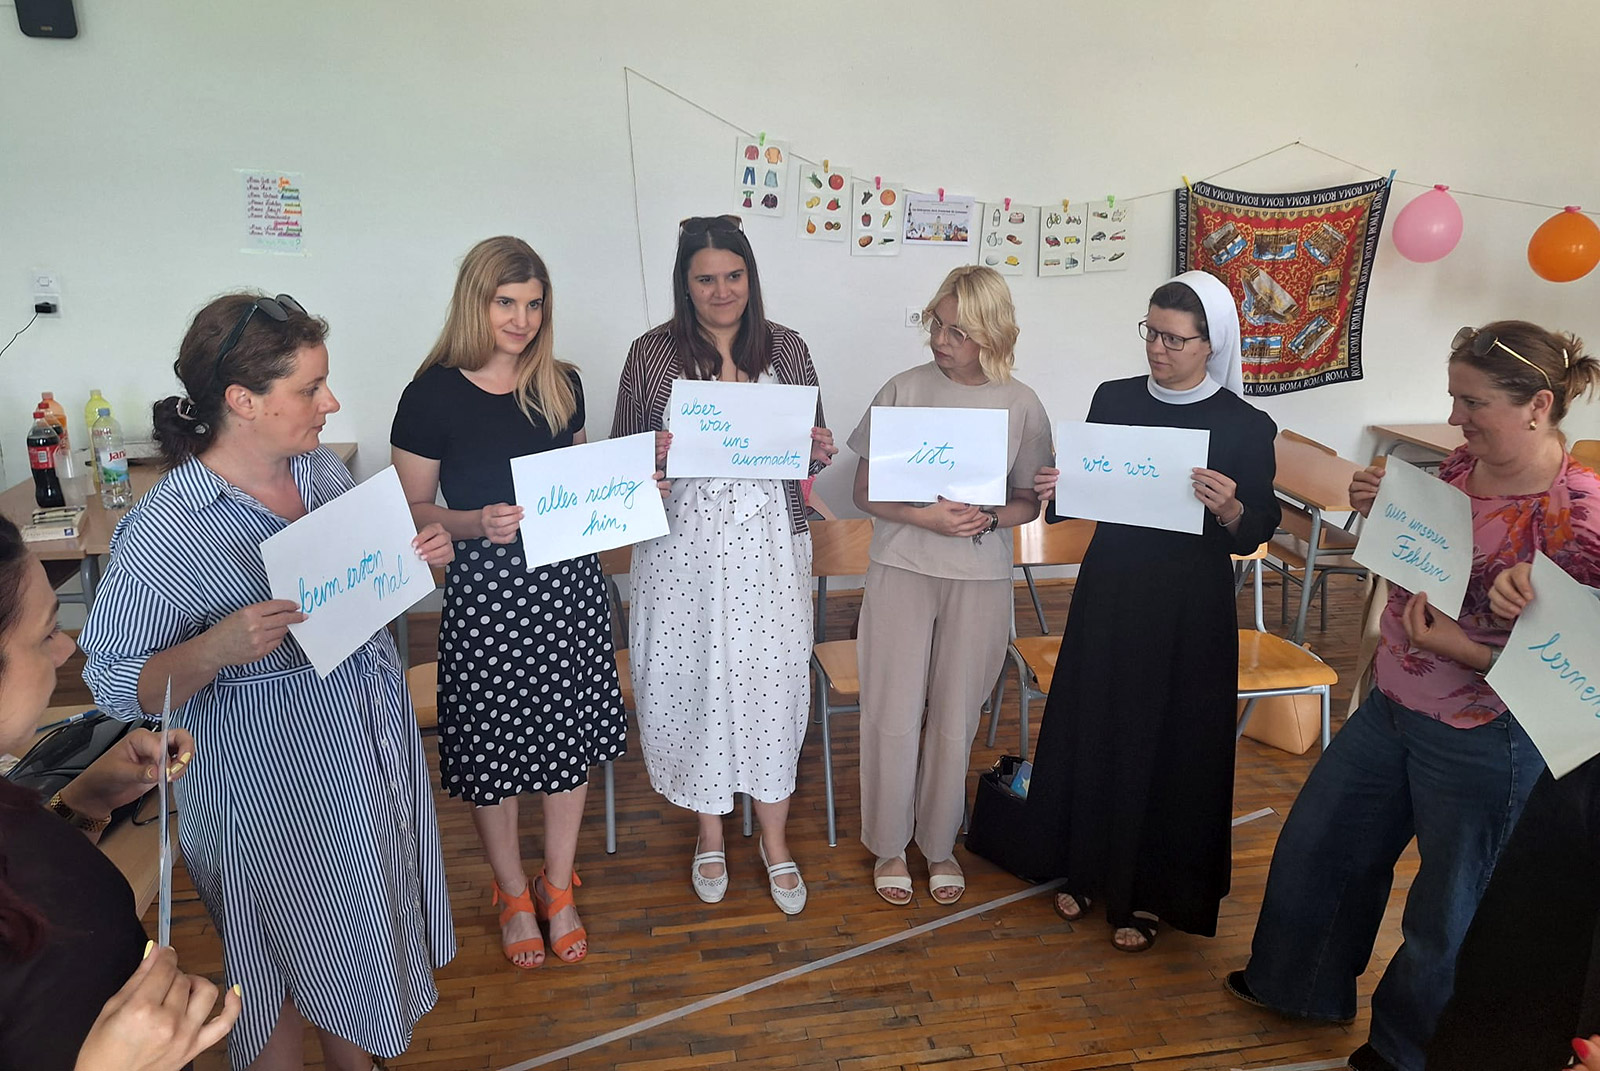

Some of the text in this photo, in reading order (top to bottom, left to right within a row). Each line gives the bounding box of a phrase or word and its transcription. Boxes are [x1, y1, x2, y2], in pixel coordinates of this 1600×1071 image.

[1193, 183, 1211, 200] ROM
[1212, 188, 1234, 202] ROMA
[1236, 195, 1259, 207] ROMA
[1261, 196, 1284, 207] ROMA
[1286, 194, 1310, 207] ROMA
[1313, 191, 1337, 204] ROMA
[1338, 186, 1363, 199] ROMA
[1368, 210, 1380, 235] ROMA
[1364, 235, 1376, 260] ROMA
[1354, 281, 1366, 306] ROMA
[1350, 307, 1362, 331] ROMA
[1350, 331, 1361, 354] ROMA
[1351, 354, 1361, 377] ROMA
[1255, 384, 1277, 393] ROMA
[1280, 380, 1301, 392] ROMA
[1303, 376, 1323, 387] ROMA
[1325, 369, 1349, 382] ROMA
[681, 398, 722, 416] aber
[700, 419, 732, 432] was
[722, 436, 749, 449] uns
[108, 448, 127, 462] Jan
[731, 449, 801, 469] ausmacht,
[907, 441, 955, 471] ist,
[1082, 455, 1160, 478] wie wir
[537, 484, 578, 516] alles
[1385, 503, 1407, 523] aus
[1392, 534, 1452, 582] Fehlern
[298, 549, 384, 615] beim ersten
